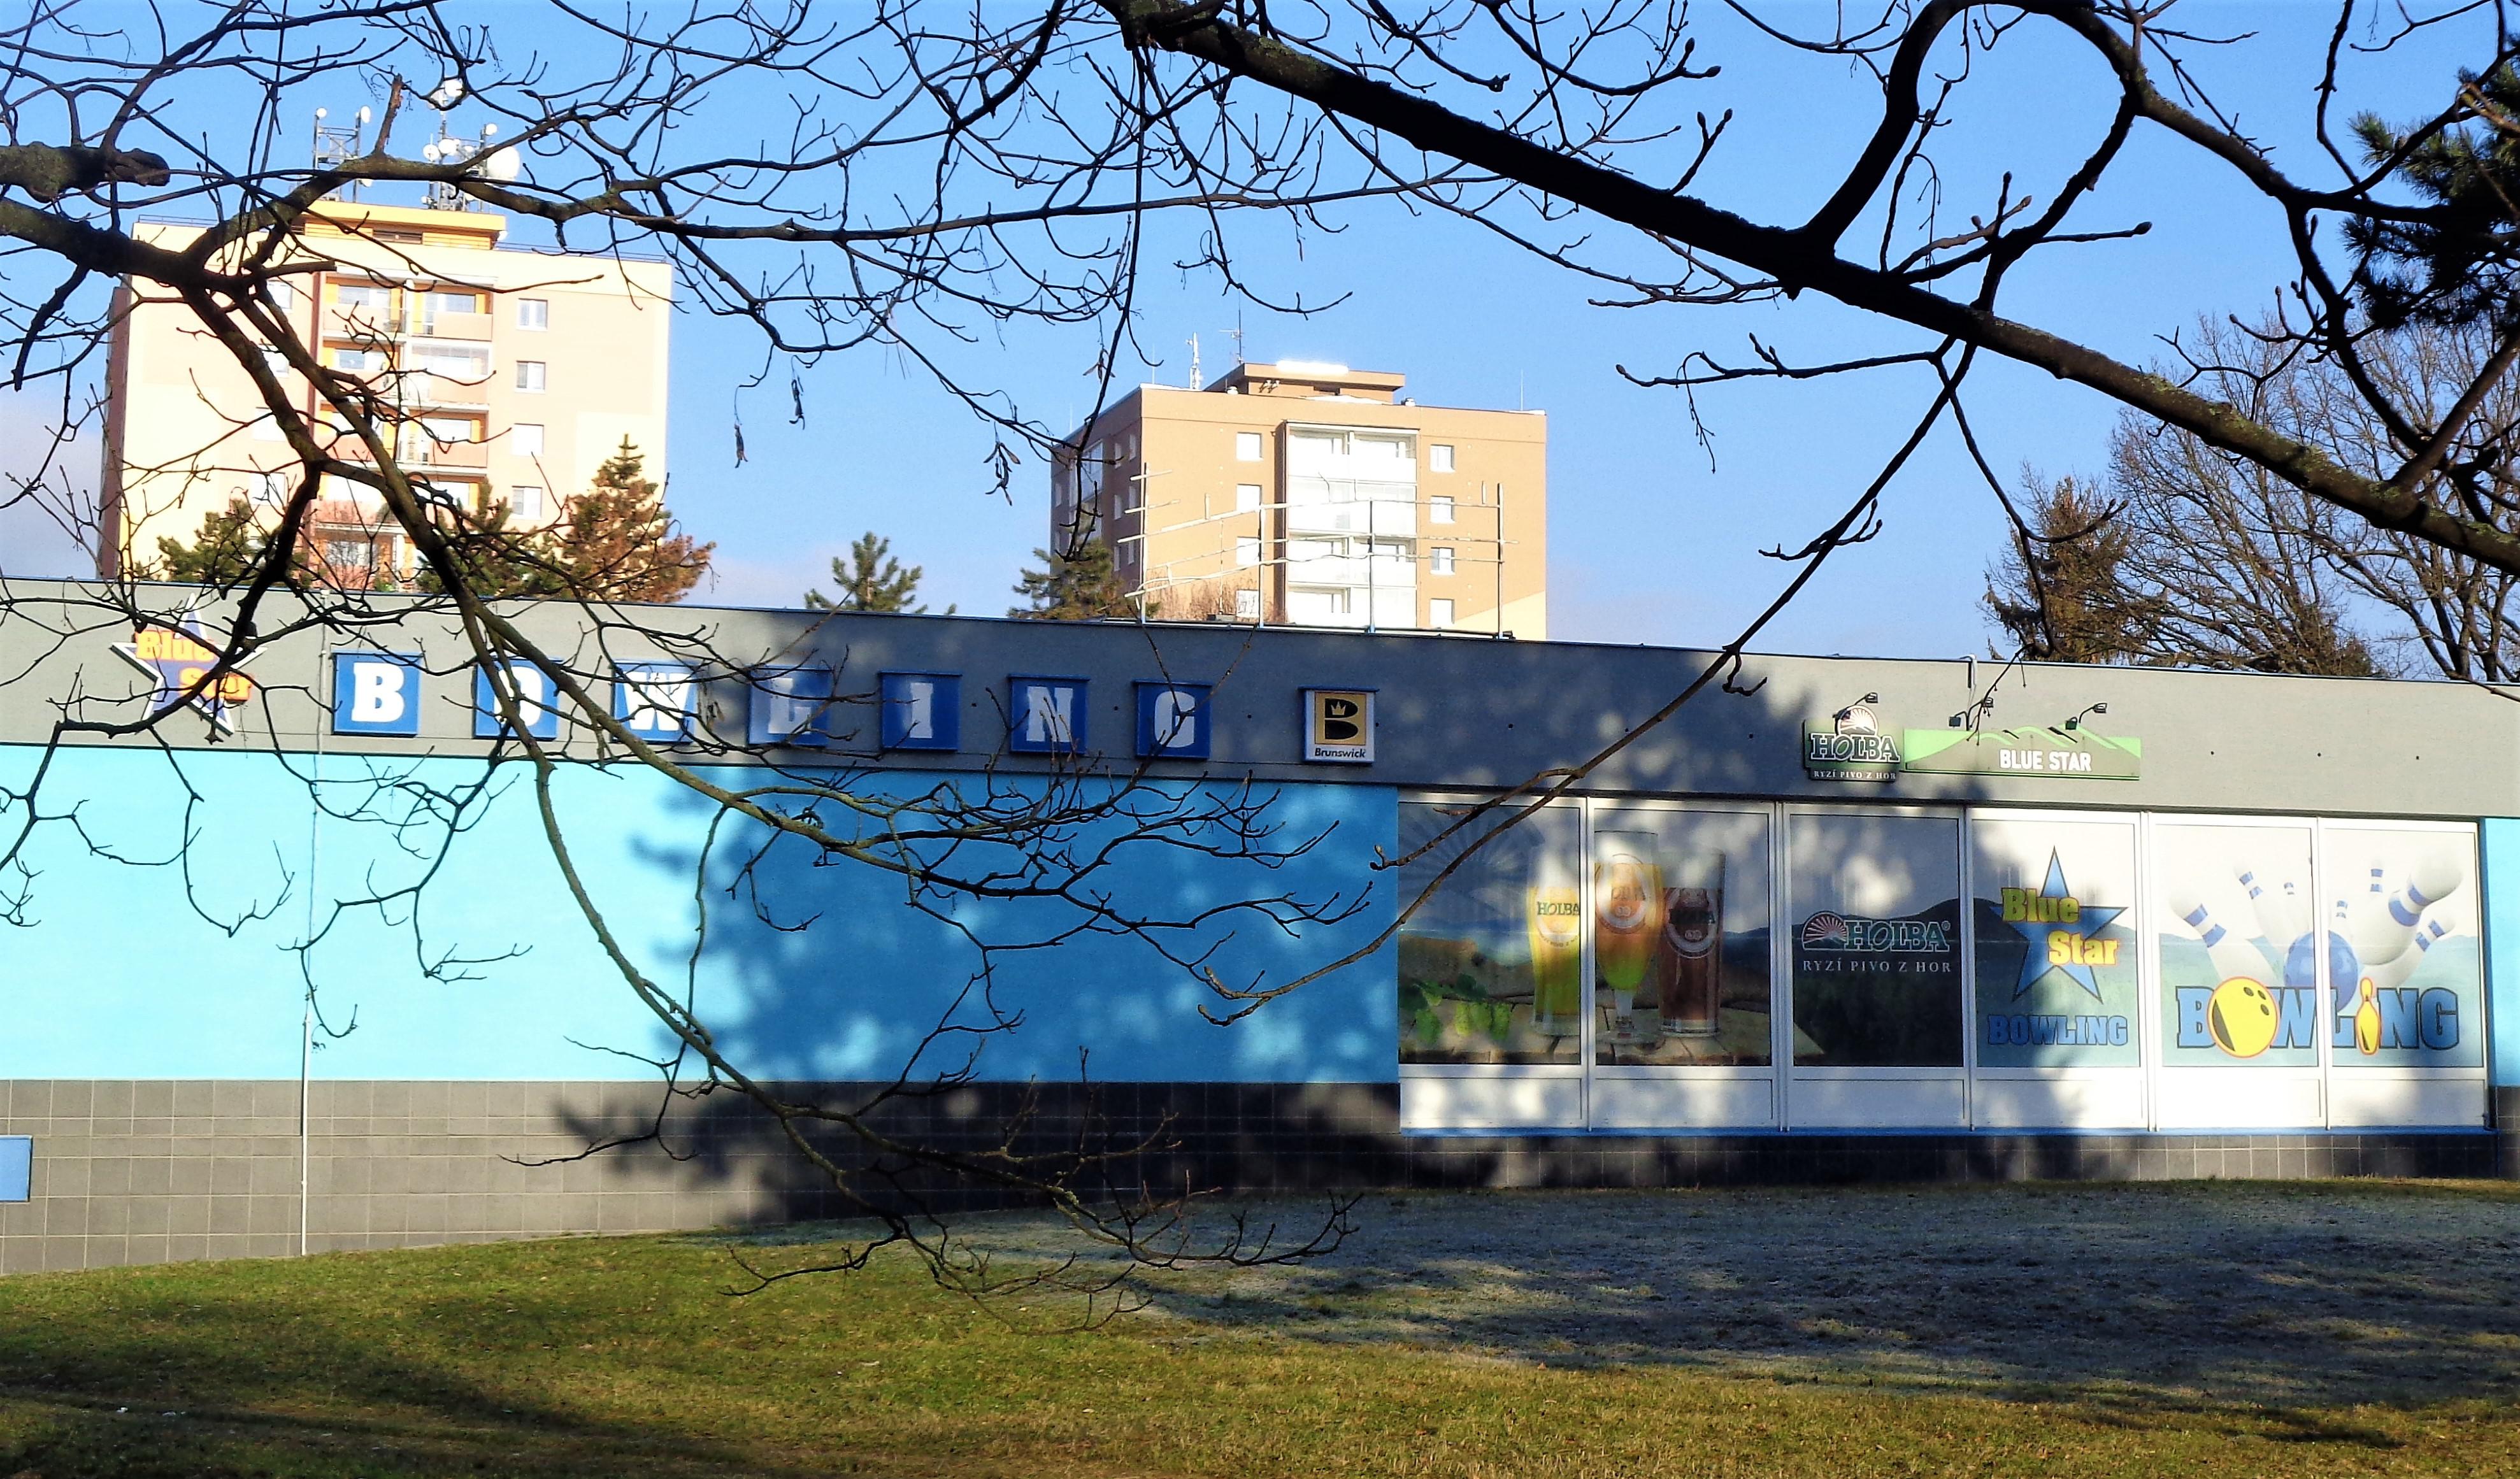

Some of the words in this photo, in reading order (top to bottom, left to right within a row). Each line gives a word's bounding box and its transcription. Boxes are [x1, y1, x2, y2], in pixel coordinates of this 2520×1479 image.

[1315, 748, 1366, 758] Brunswick
[1810, 733, 1901, 762] HOLBA
[2000, 749, 2044, 770] BLUE
[2049, 751, 2092, 772] STAR
[1535, 901, 1580, 915] HOLBA
[2001, 887, 2080, 924] Blue
[2047, 929, 2119, 966] Star
[1803, 958, 1842, 972] RYZÍ
[1851, 961, 1891, 972] PIVO
[1898, 962, 1907, 973] Z
[1916, 962, 1952, 973] HOR
[1987, 1015, 2128, 1046] BOWLING
[2175, 976, 2461, 1058] BOWLING
